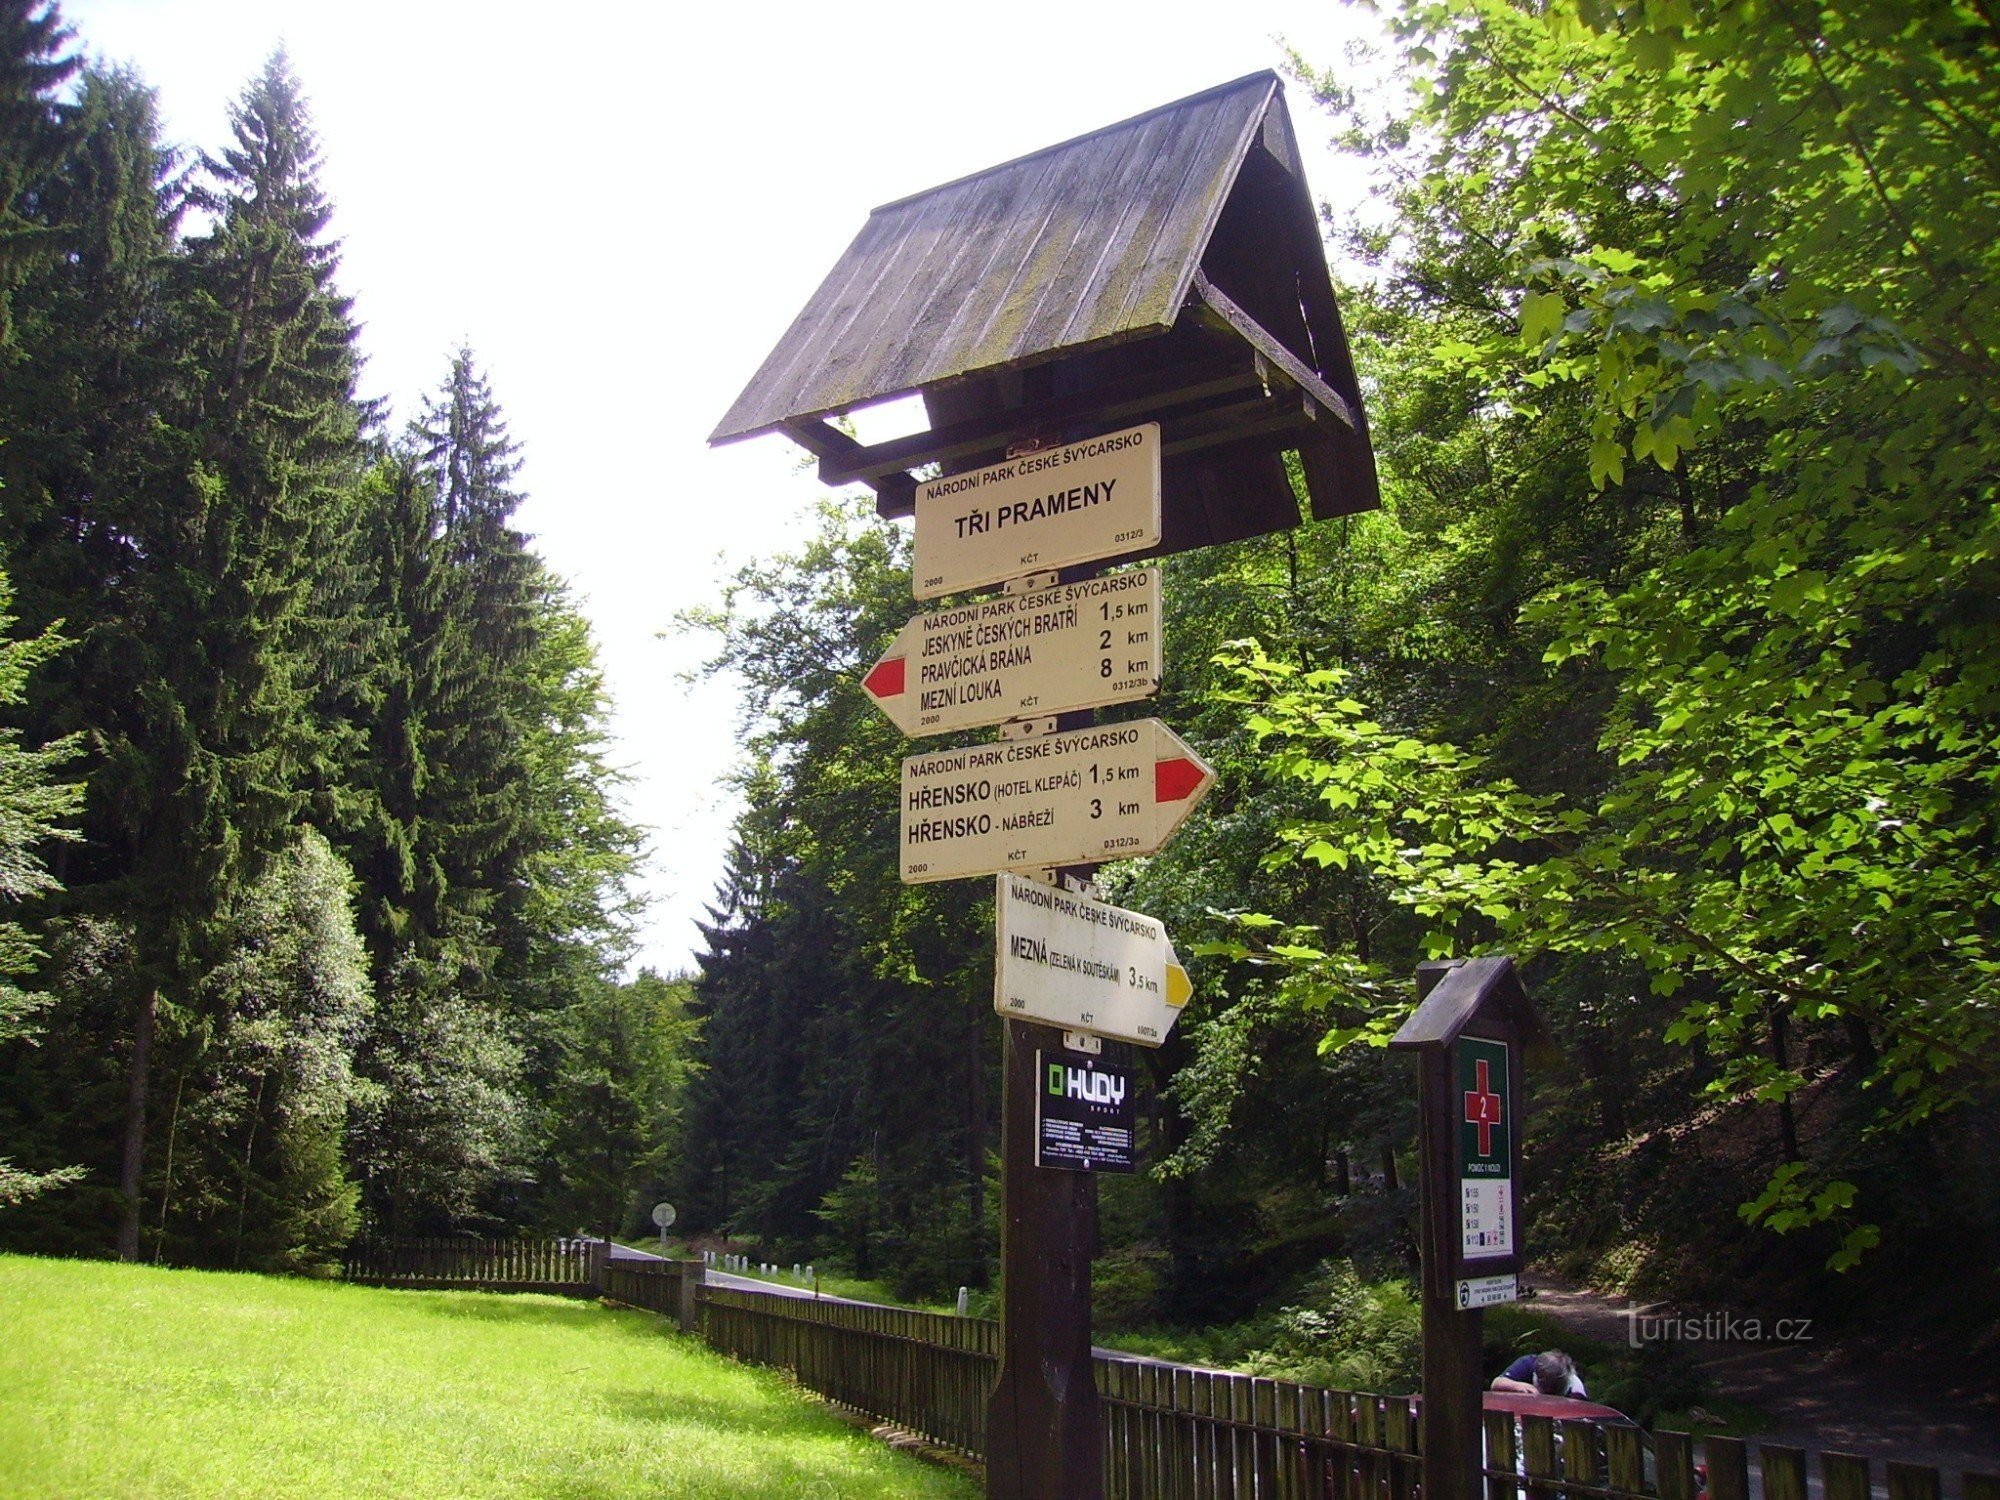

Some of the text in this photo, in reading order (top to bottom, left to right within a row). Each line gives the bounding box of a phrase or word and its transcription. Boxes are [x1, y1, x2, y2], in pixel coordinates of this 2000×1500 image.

[926, 432, 1143, 500] NÁRODNÍ PARK ČESKÉ ŠVÝCARSKO
[954, 479, 1117, 539] TŘI PRAMENY
[1114, 529, 1144, 543] 0312/3
[1020, 553, 1039, 565] KČT
[924, 576, 943, 588] 2000
[923, 573, 1148, 632] NÁRODNÍ PARK ČESKÉ ŠVÝCARSKO
[922, 601, 1148, 658] JESKYNĚ ČESKÝCH BRATŘÍ 1,5 km
[921, 629, 1148, 684] PRAVČICKÁ BRÁNA 2 km
[920, 658, 1149, 711] MEZNÍ LOUKA 8 km
[1112, 678, 1148, 691] 0312/3b
[1020, 696, 1039, 708] KČT
[920, 714, 940, 726] 2000
[909, 728, 1139, 778] NÁRODNÍ PARK ČESKÉ ŠVÝCARSKO
[909, 763, 1139, 811] HŘENSKO (HOTEL KLEPÁČ) 1,5 km
[908, 814, 991, 844] HŘENSKO
[1002, 807, 1055, 832] NÁBŘEŽÍ
[1090, 798, 1102, 819] 3
[1118, 801, 1140, 816] km
[1008, 850, 1027, 861] KČT
[1103, 837, 1140, 849] 0312/3a
[908, 863, 928, 874] 2000
[1011, 884, 1157, 941] NÁRODNÍ PARK ČESKÉ ŠVÝCARSKO
[1010, 934, 1048, 964] MEZNÁ
[1049, 951, 1076, 972] (ZELENÁ
[1077, 958, 1082, 973] K
[1128, 966, 1144, 990] 3,5
[1145, 976, 1158, 994] km
[1010, 997, 1025, 1009] 2000
[1080, 1011, 1094, 1024] KČT
[1067, 1067, 1125, 1105] HUDY
[1479, 1096, 1487, 1118] 2
